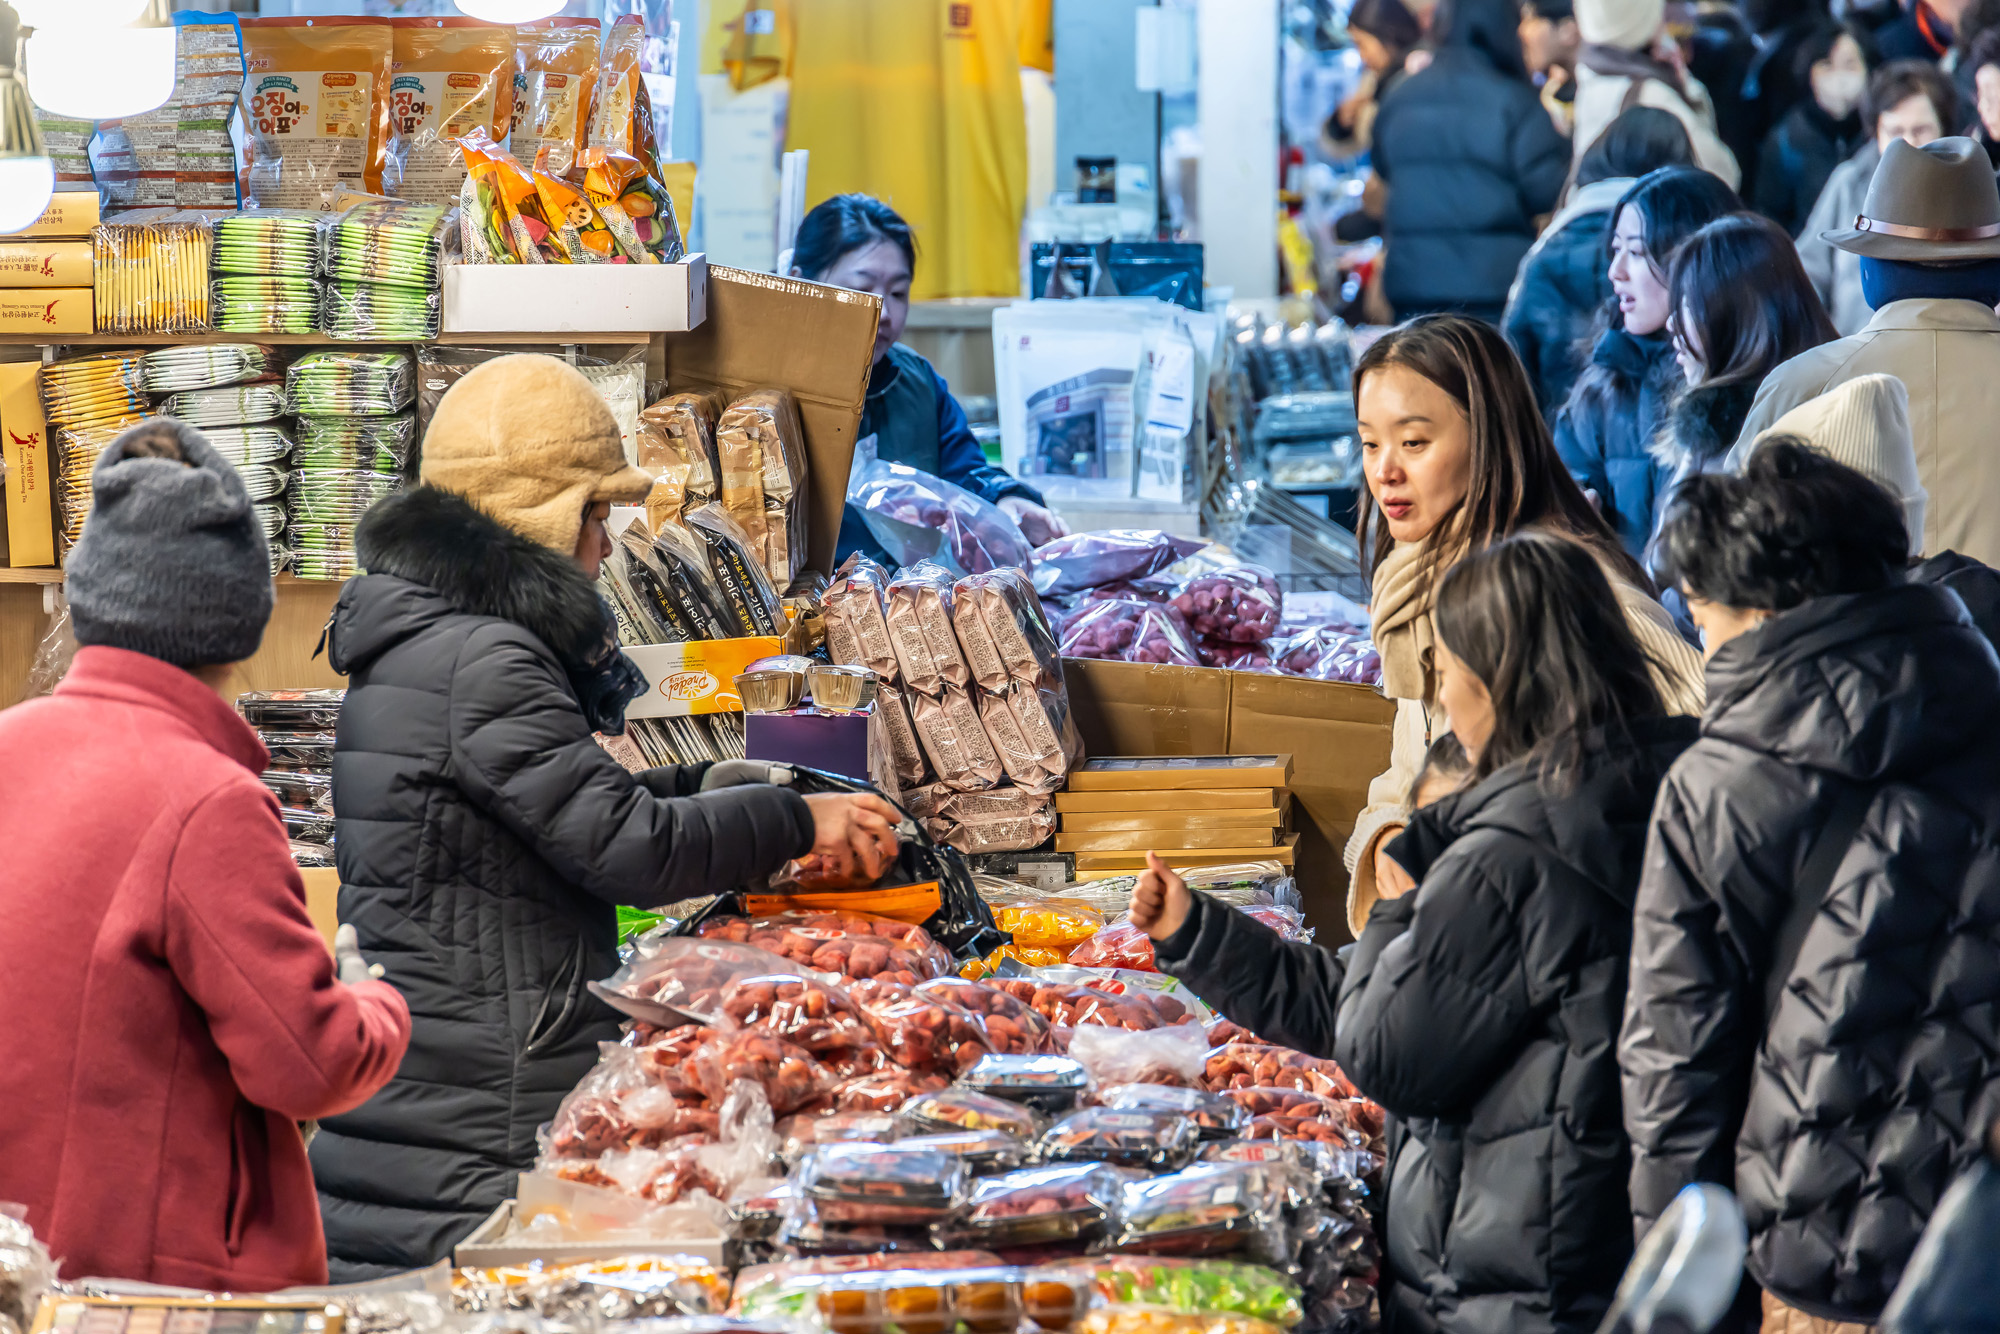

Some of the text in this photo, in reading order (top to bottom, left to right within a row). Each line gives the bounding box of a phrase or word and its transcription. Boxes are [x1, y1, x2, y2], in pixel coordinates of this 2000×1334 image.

[732, 555, 750, 588] 마요네즈
[657, 590, 677, 621] 마요네즈
[668, 670, 709, 702] Predel
